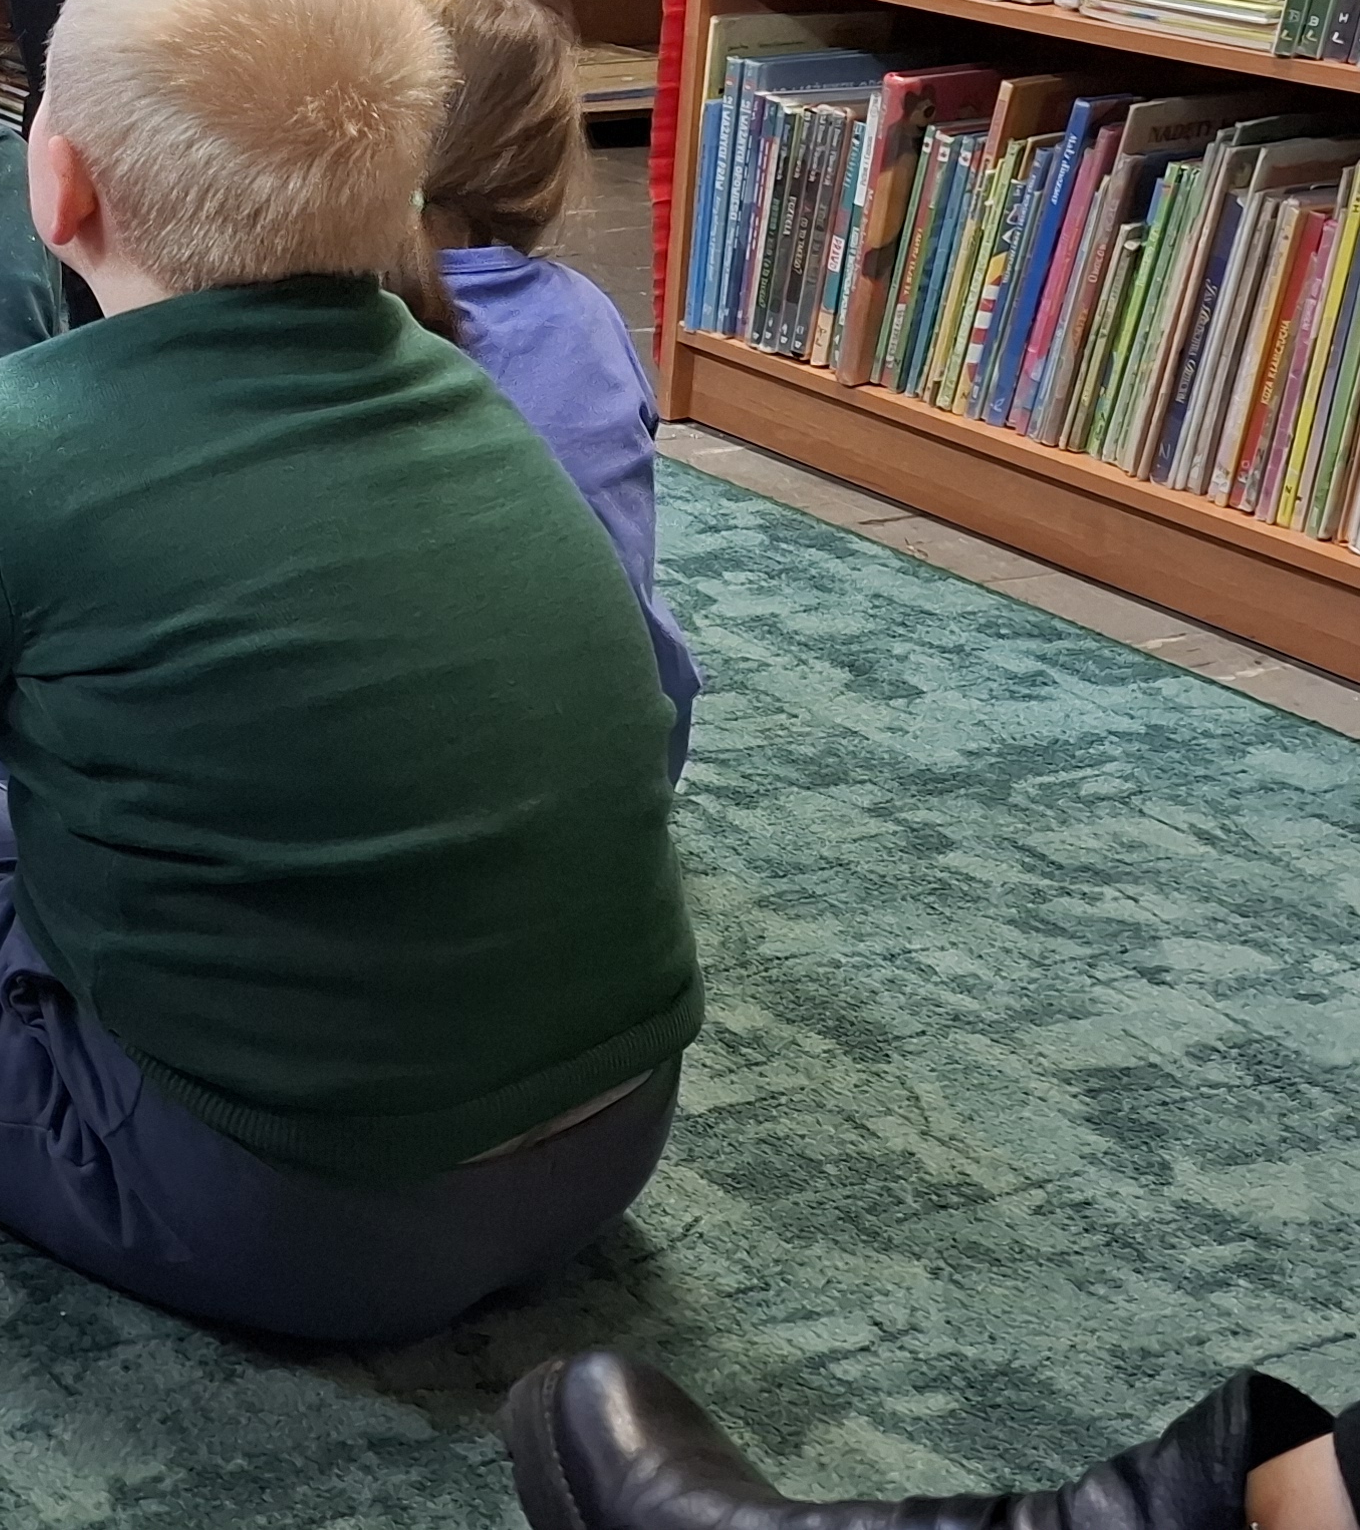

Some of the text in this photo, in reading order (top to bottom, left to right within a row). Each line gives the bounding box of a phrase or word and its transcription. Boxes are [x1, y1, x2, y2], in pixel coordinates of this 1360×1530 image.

[716, 110, 731, 160] WAŻNYCH
[734, 114, 749, 163] WAŻNYCH
[715, 162, 729, 191] PRAW
[829, 238, 842, 271] PRAWO
[1260, 320, 1292, 405] KOZA KŁAMCZUCHA
